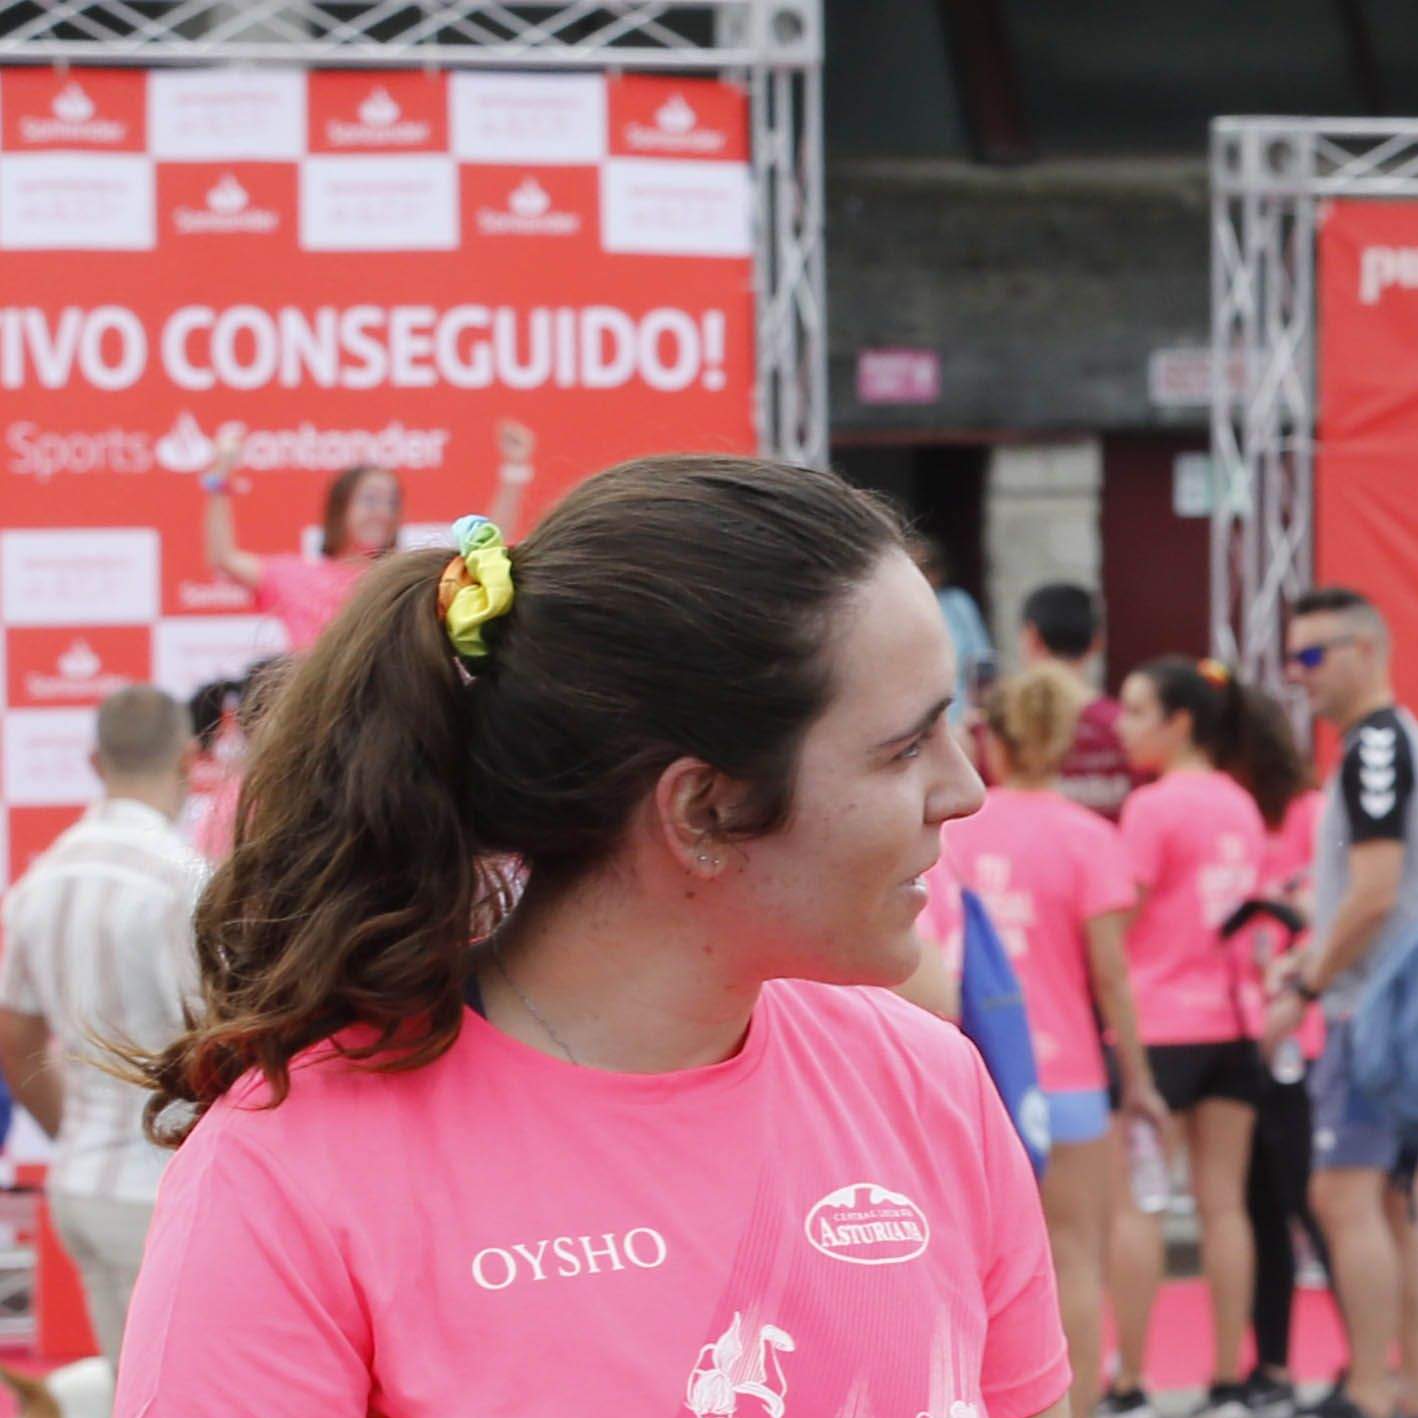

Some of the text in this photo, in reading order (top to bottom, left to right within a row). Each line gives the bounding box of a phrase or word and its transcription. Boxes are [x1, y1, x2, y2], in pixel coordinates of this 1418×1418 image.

[161, 304, 728, 392] CONSEGUIDO!
[6, 420, 152, 481] Sports
[471, 1227, 668, 1291] OYSHO
